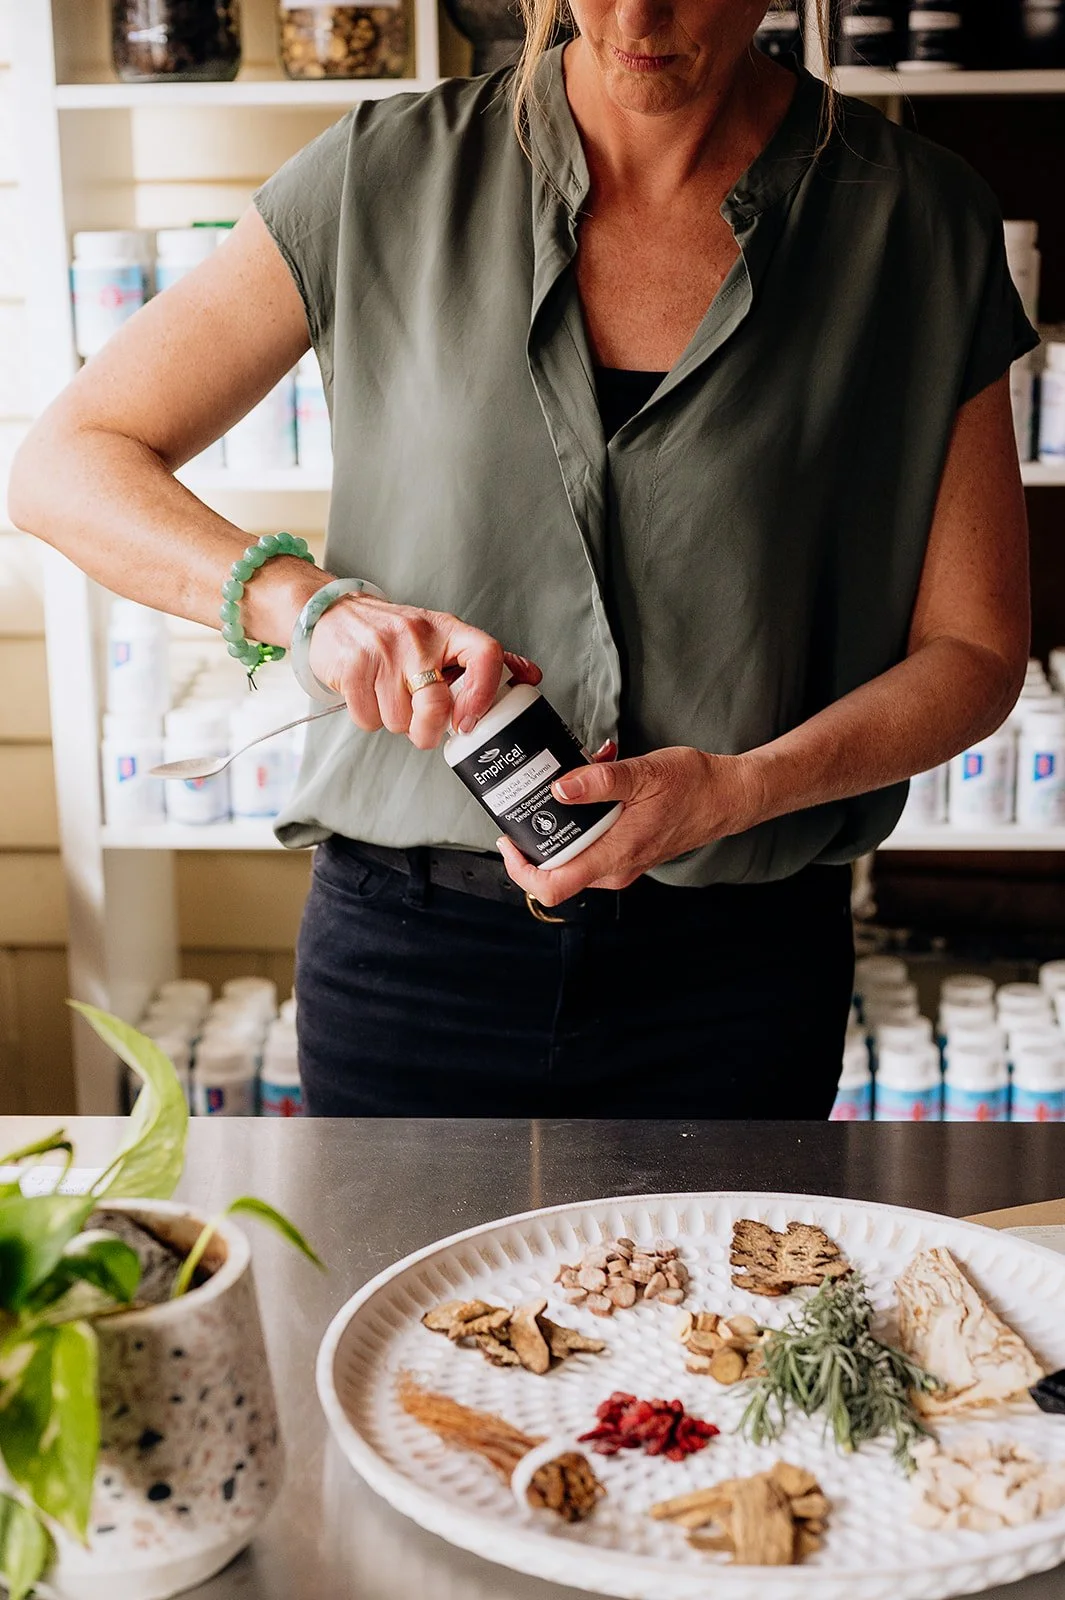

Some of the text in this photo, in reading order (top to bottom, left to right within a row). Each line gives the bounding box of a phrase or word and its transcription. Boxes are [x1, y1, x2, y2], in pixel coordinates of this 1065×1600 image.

[473, 744, 523, 785] Empirical
[504, 806, 522, 821] Organic
[514, 809, 532, 823] Extract
[549, 820, 577, 842] Supplement
